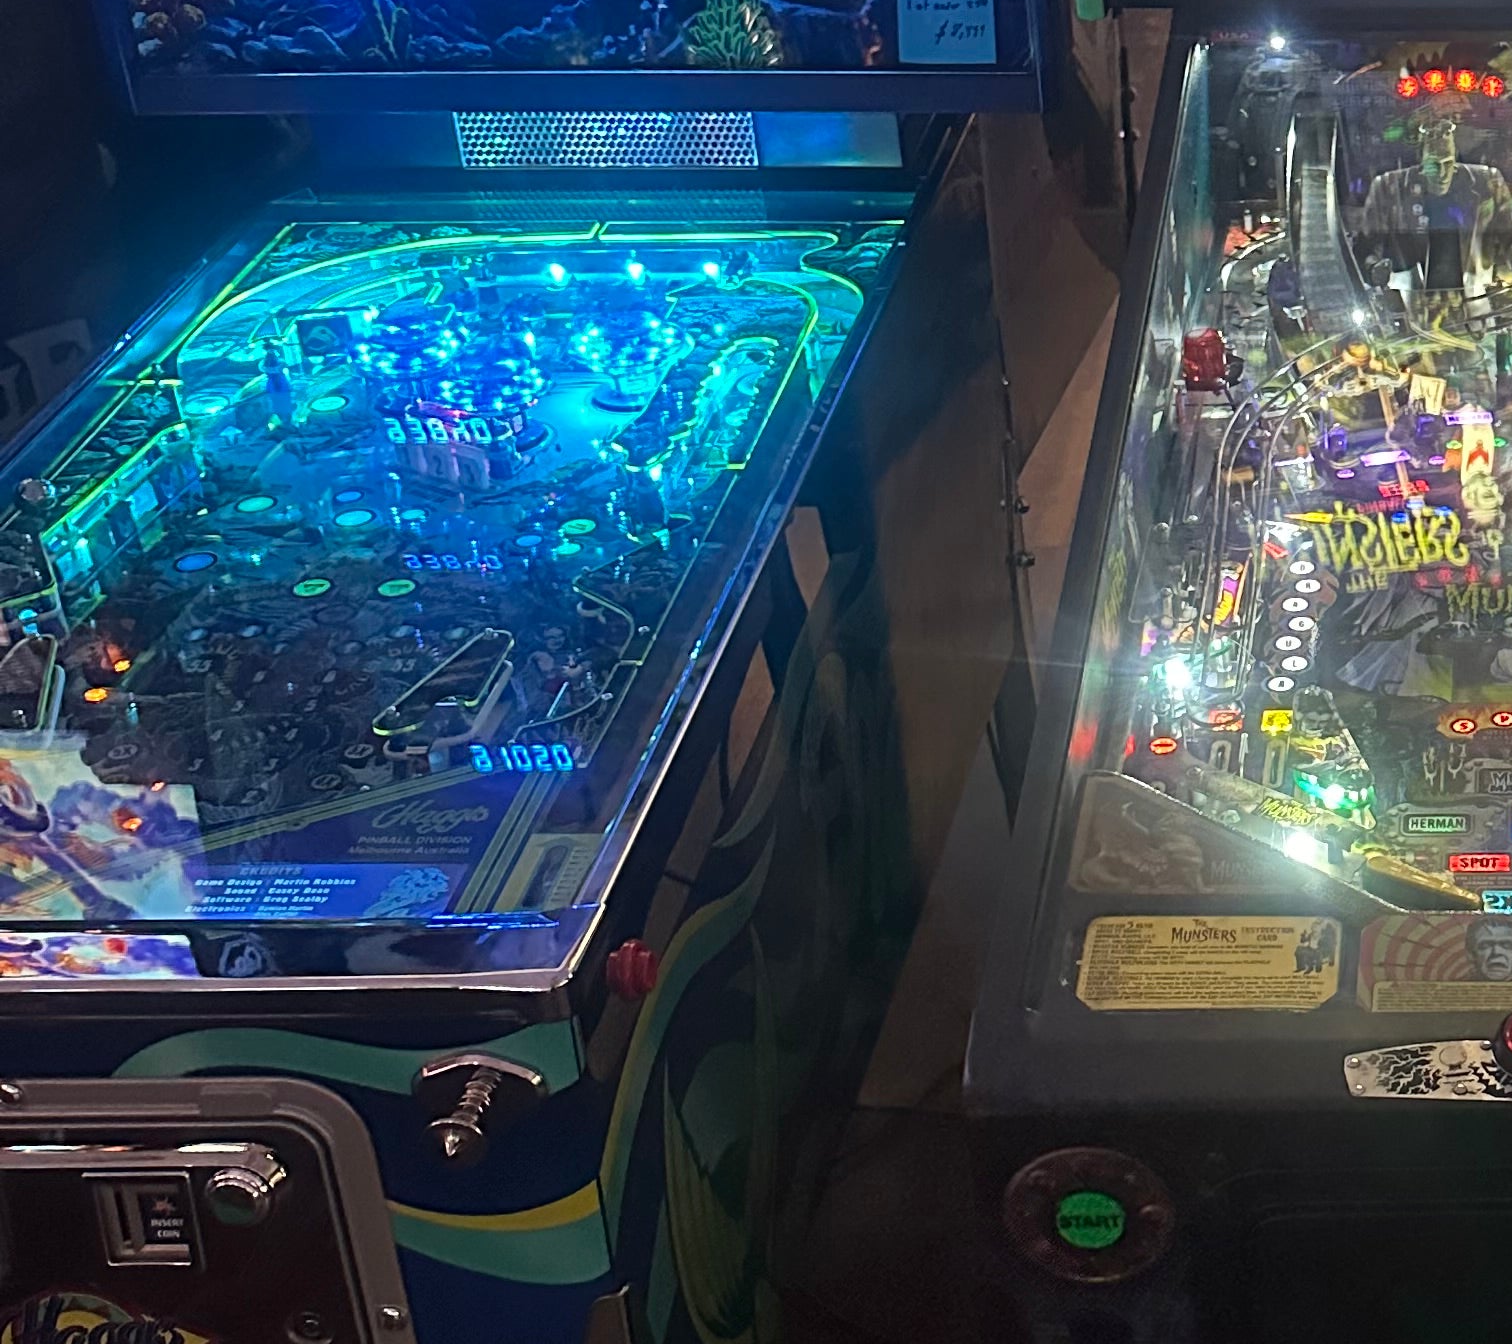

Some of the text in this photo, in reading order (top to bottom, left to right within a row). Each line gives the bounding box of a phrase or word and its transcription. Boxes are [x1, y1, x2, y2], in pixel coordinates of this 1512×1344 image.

[1260, 799, 1317, 825] MUNSTERS
[1410, 818, 1464, 829] HERMAN
[358, 835, 472, 845] PINBALL DIVISION
[1460, 858, 1501, 868] SPOT
[1171, 927, 1238, 945] MUNSTERS
[150, 1218, 184, 1228] INSERT
[1059, 1214, 1120, 1233] START
[157, 1230, 181, 1238] COIN
